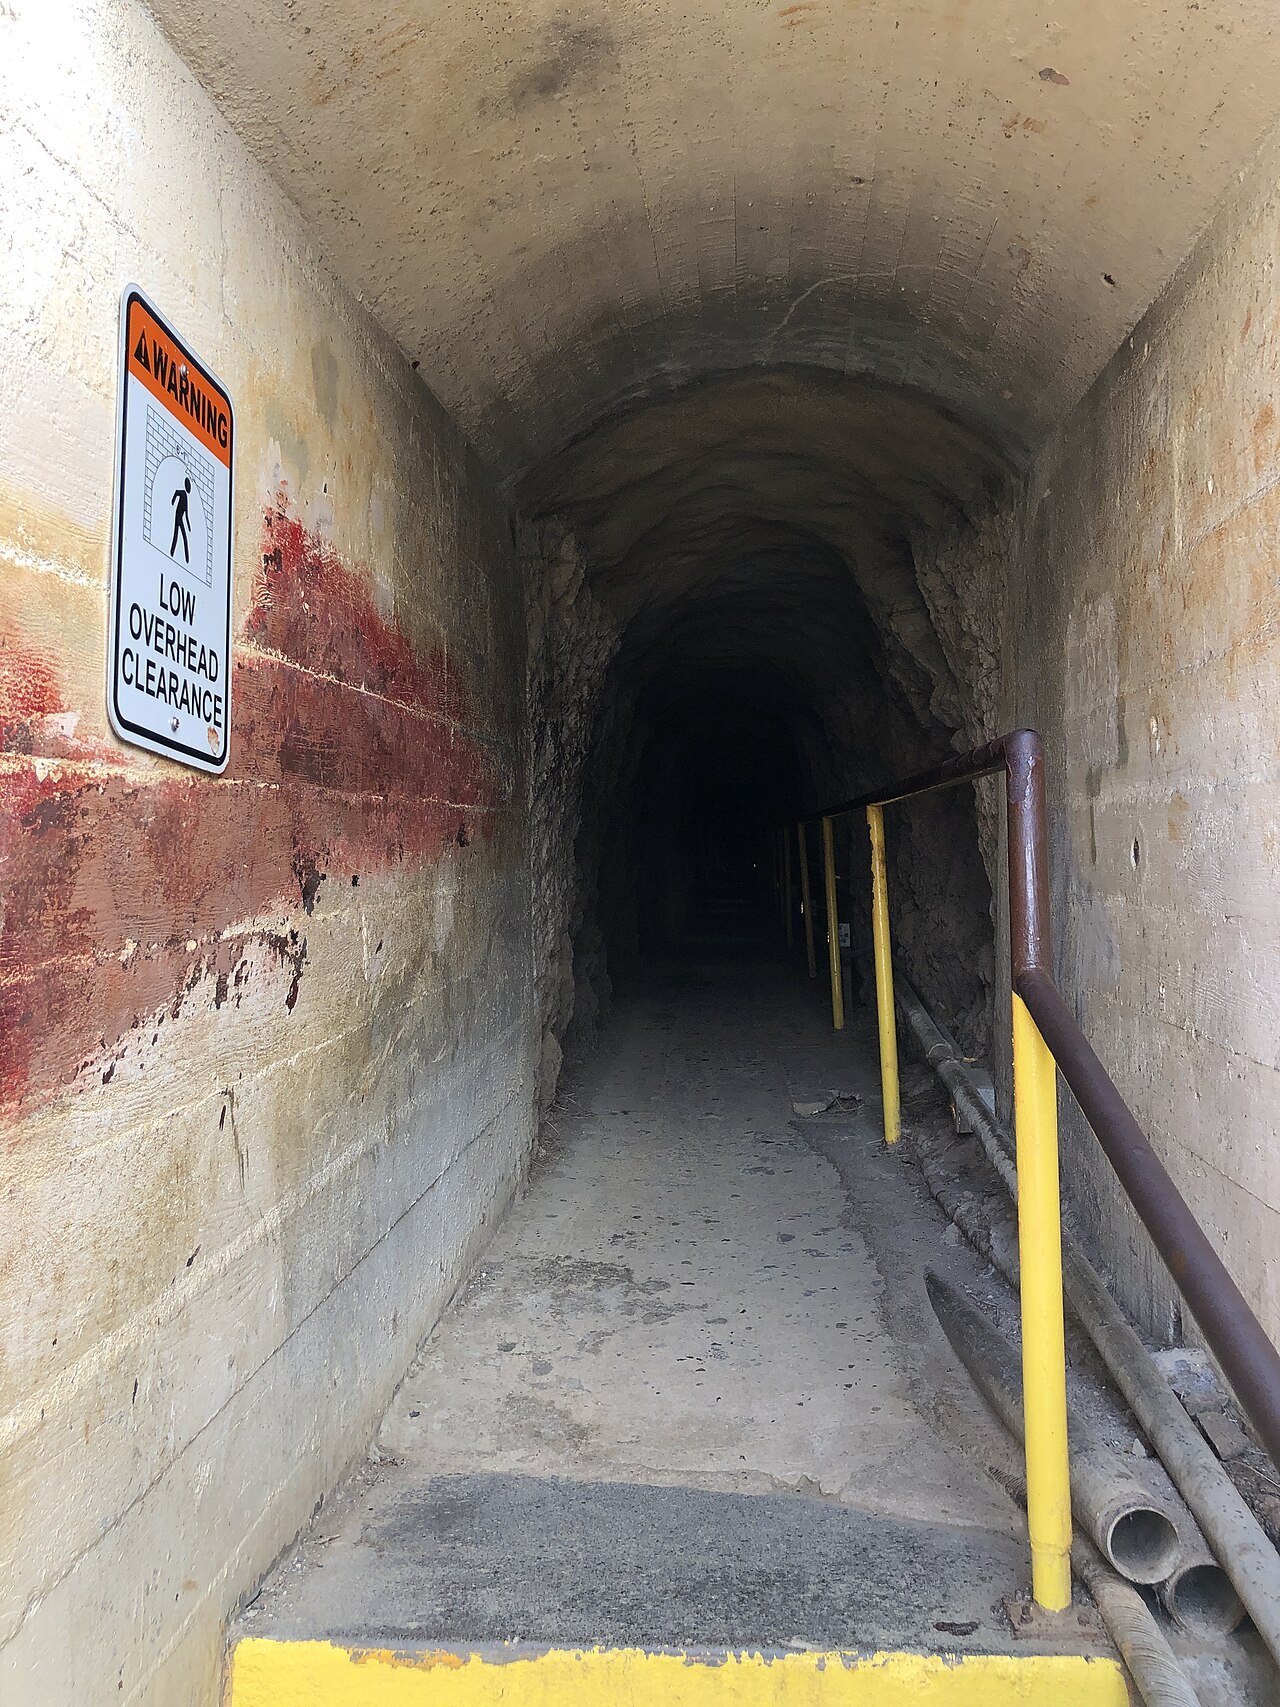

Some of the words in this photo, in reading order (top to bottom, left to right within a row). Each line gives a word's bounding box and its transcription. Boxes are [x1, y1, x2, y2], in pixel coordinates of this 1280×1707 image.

[153, 339, 228, 449] WARNING
[159, 572, 196, 626] LOW
[129, 602, 219, 683] OVERHEAD
[122, 647, 223, 729] CLEARANCE
